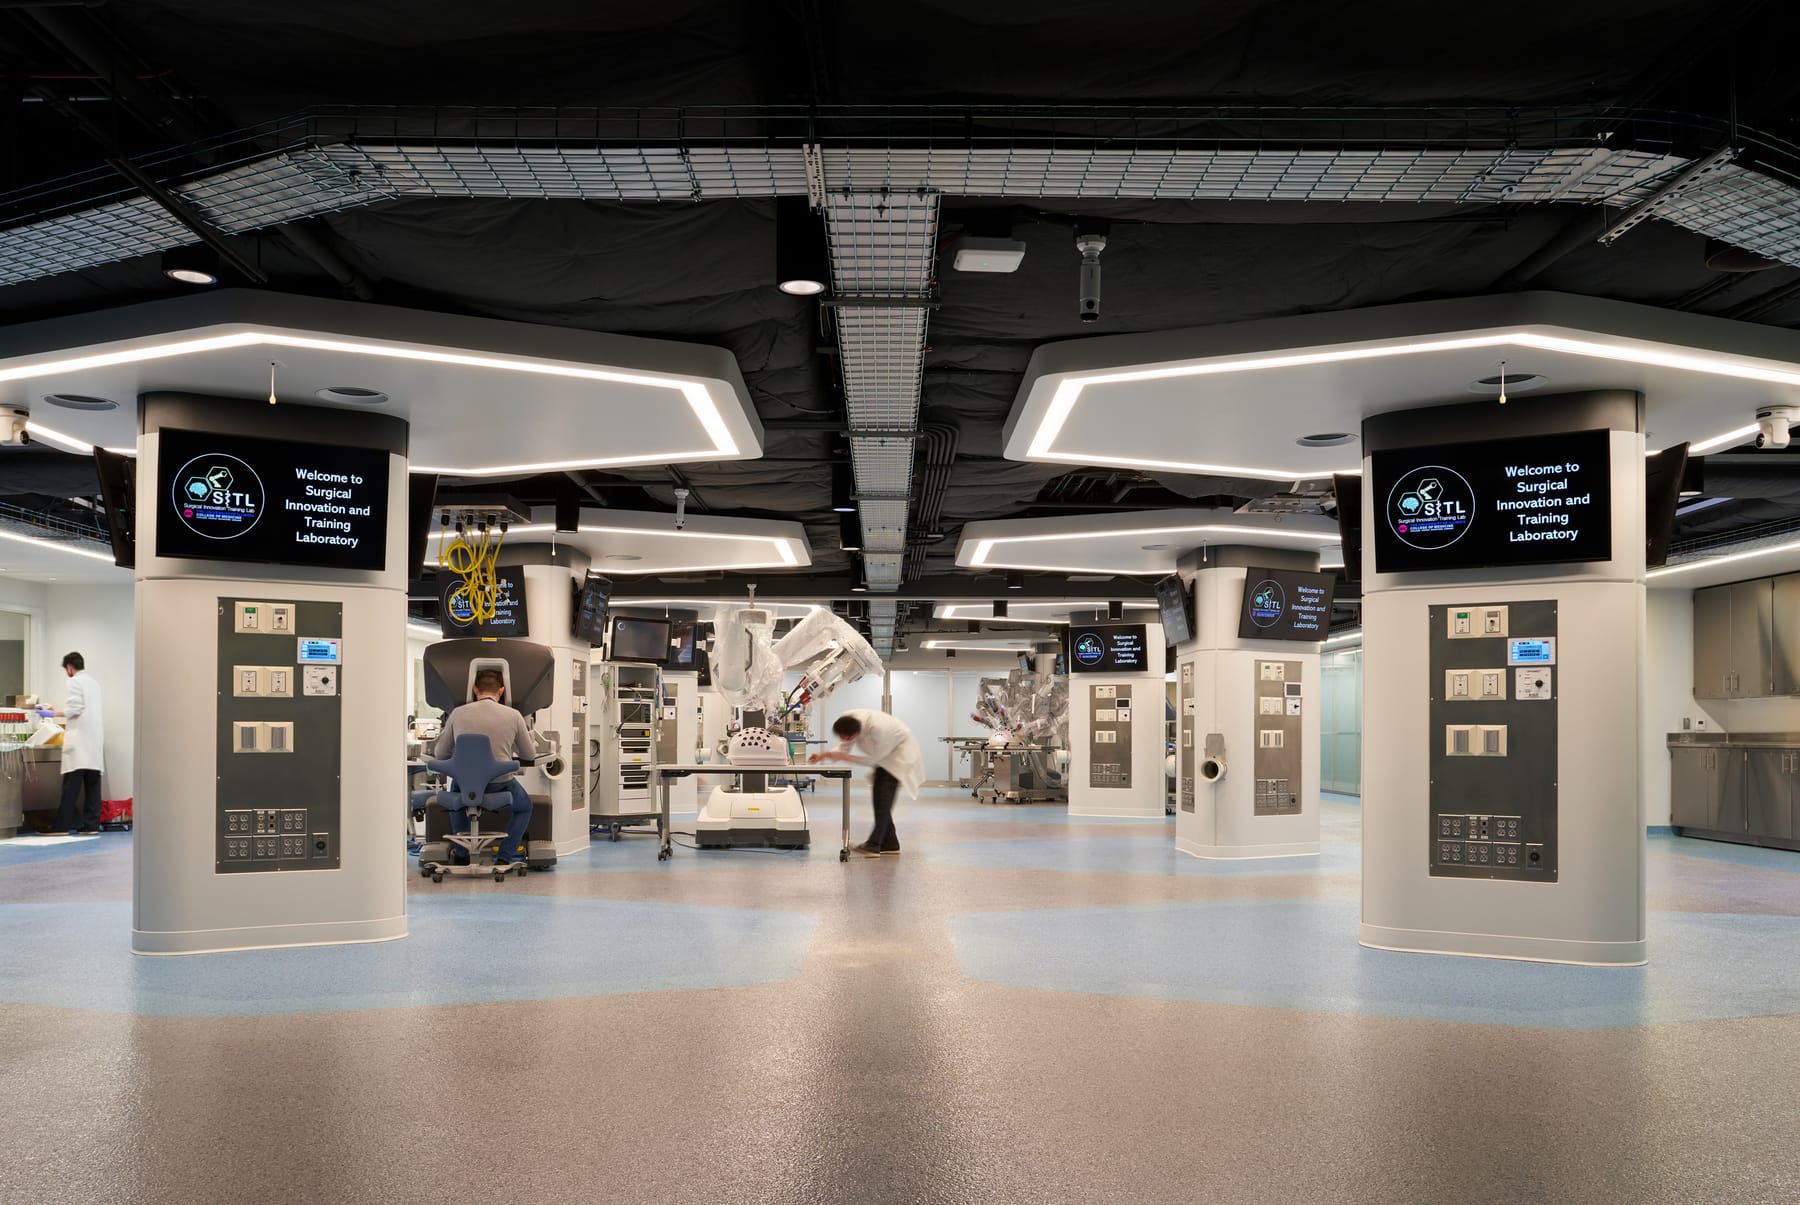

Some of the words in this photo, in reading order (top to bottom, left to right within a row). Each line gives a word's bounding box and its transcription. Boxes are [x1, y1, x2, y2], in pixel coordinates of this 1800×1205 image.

[295, 468, 348, 483] Welcome
[350, 474, 363, 484] to
[1505, 464, 1562, 477] Welcome
[1565, 462, 1580, 473] to
[305, 485, 352, 500] Surgical
[1517, 478, 1568, 494] Surgical
[285, 499, 346, 514] Innovation
[348, 506, 370, 516] and
[1497, 496, 1562, 511] Innovation
[1565, 492, 1590, 505] and
[304, 516, 351, 532] Training
[1516, 512, 1569, 525] Training
[296, 531, 359, 548] Laboratory
[1509, 529, 1579, 542] Laboratory
[1298, 586, 1318, 594] Welcome
[1300, 596, 1320, 604] Surgical
[1292, 604, 1316, 612] Innovation
[490, 618, 516, 627] Laboratory
[1298, 612, 1318, 622] Training
[1294, 622, 1319, 630] Laboratory
